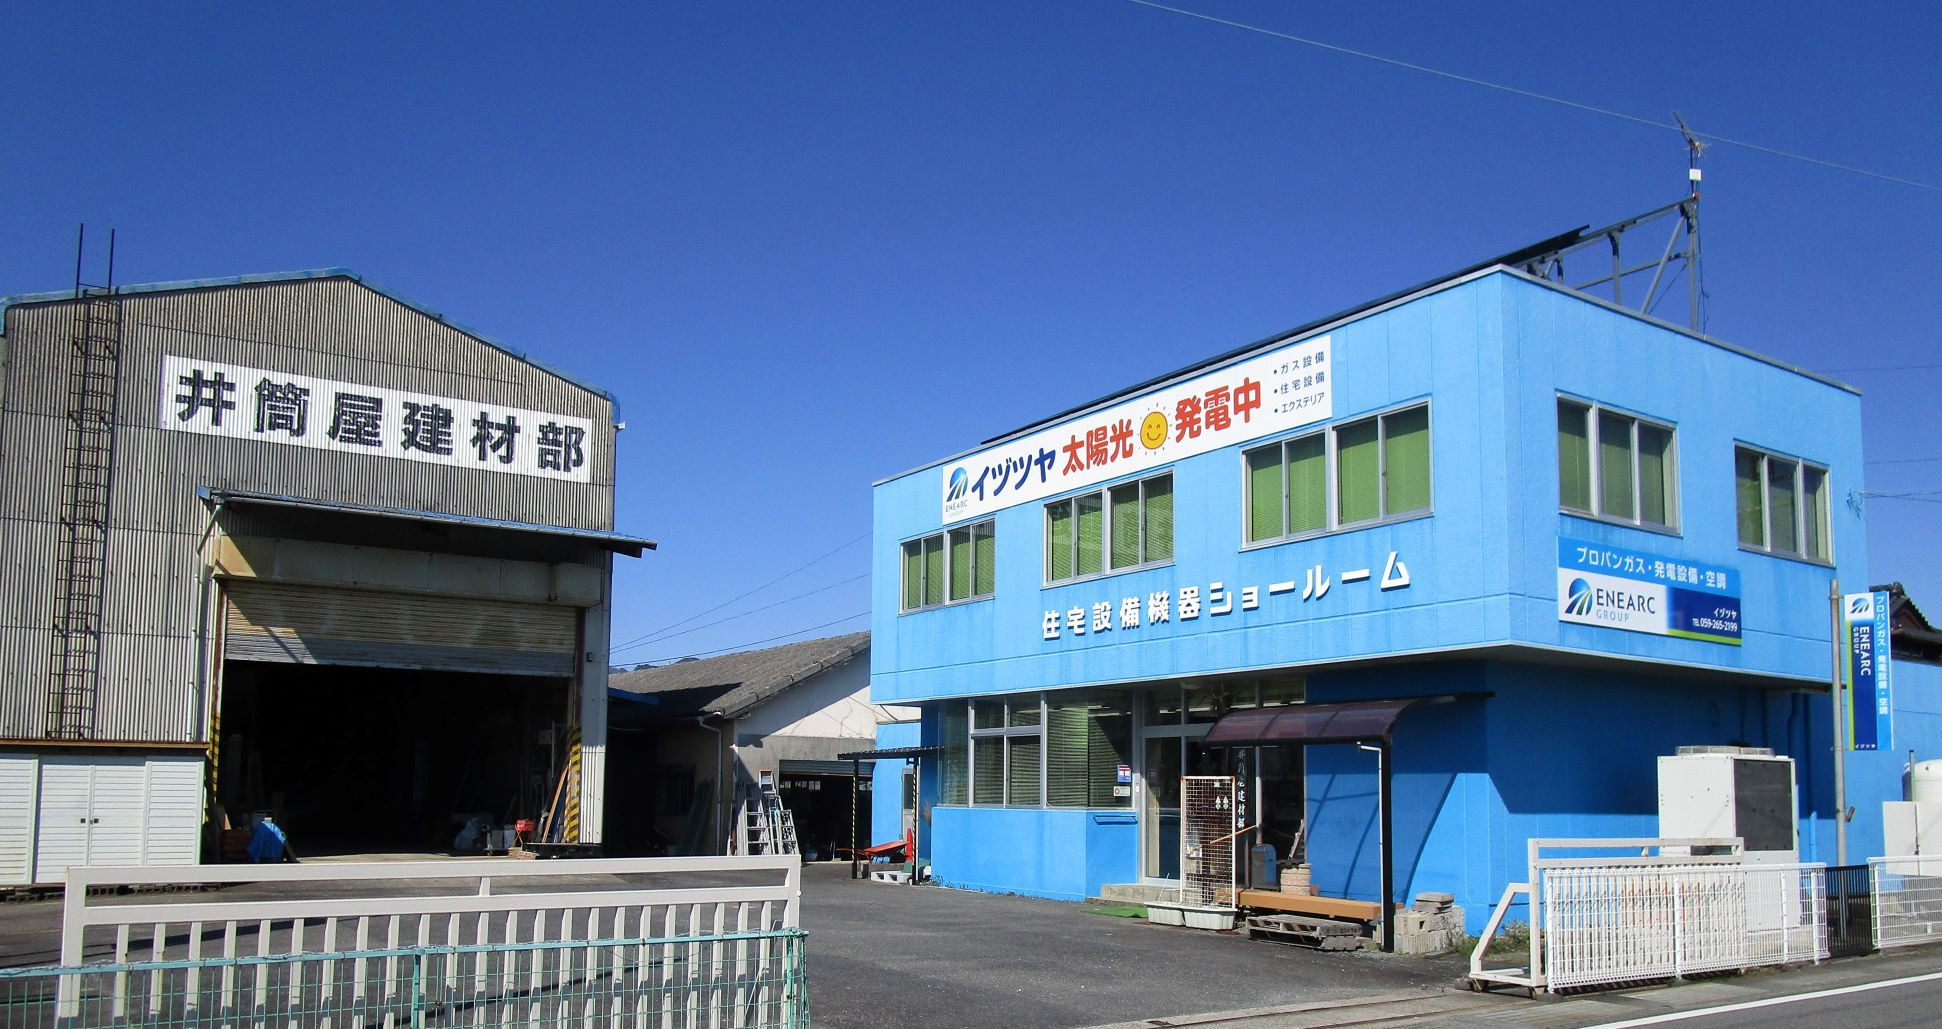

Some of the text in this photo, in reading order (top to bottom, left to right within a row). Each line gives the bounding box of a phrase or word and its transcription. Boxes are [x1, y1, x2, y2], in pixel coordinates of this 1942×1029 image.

[175, 369, 586, 473] 井筒屋建材部
[971, 377, 1262, 502] イヅツヤ 太陽光 発電中
[1041, 551, 1411, 640] 住宅設備機器ショールーム
[1596, 588, 1656, 614] ENEARC
[1596, 610, 1630, 622] GROUP
[1859, 626, 1871, 676] ENEARC
